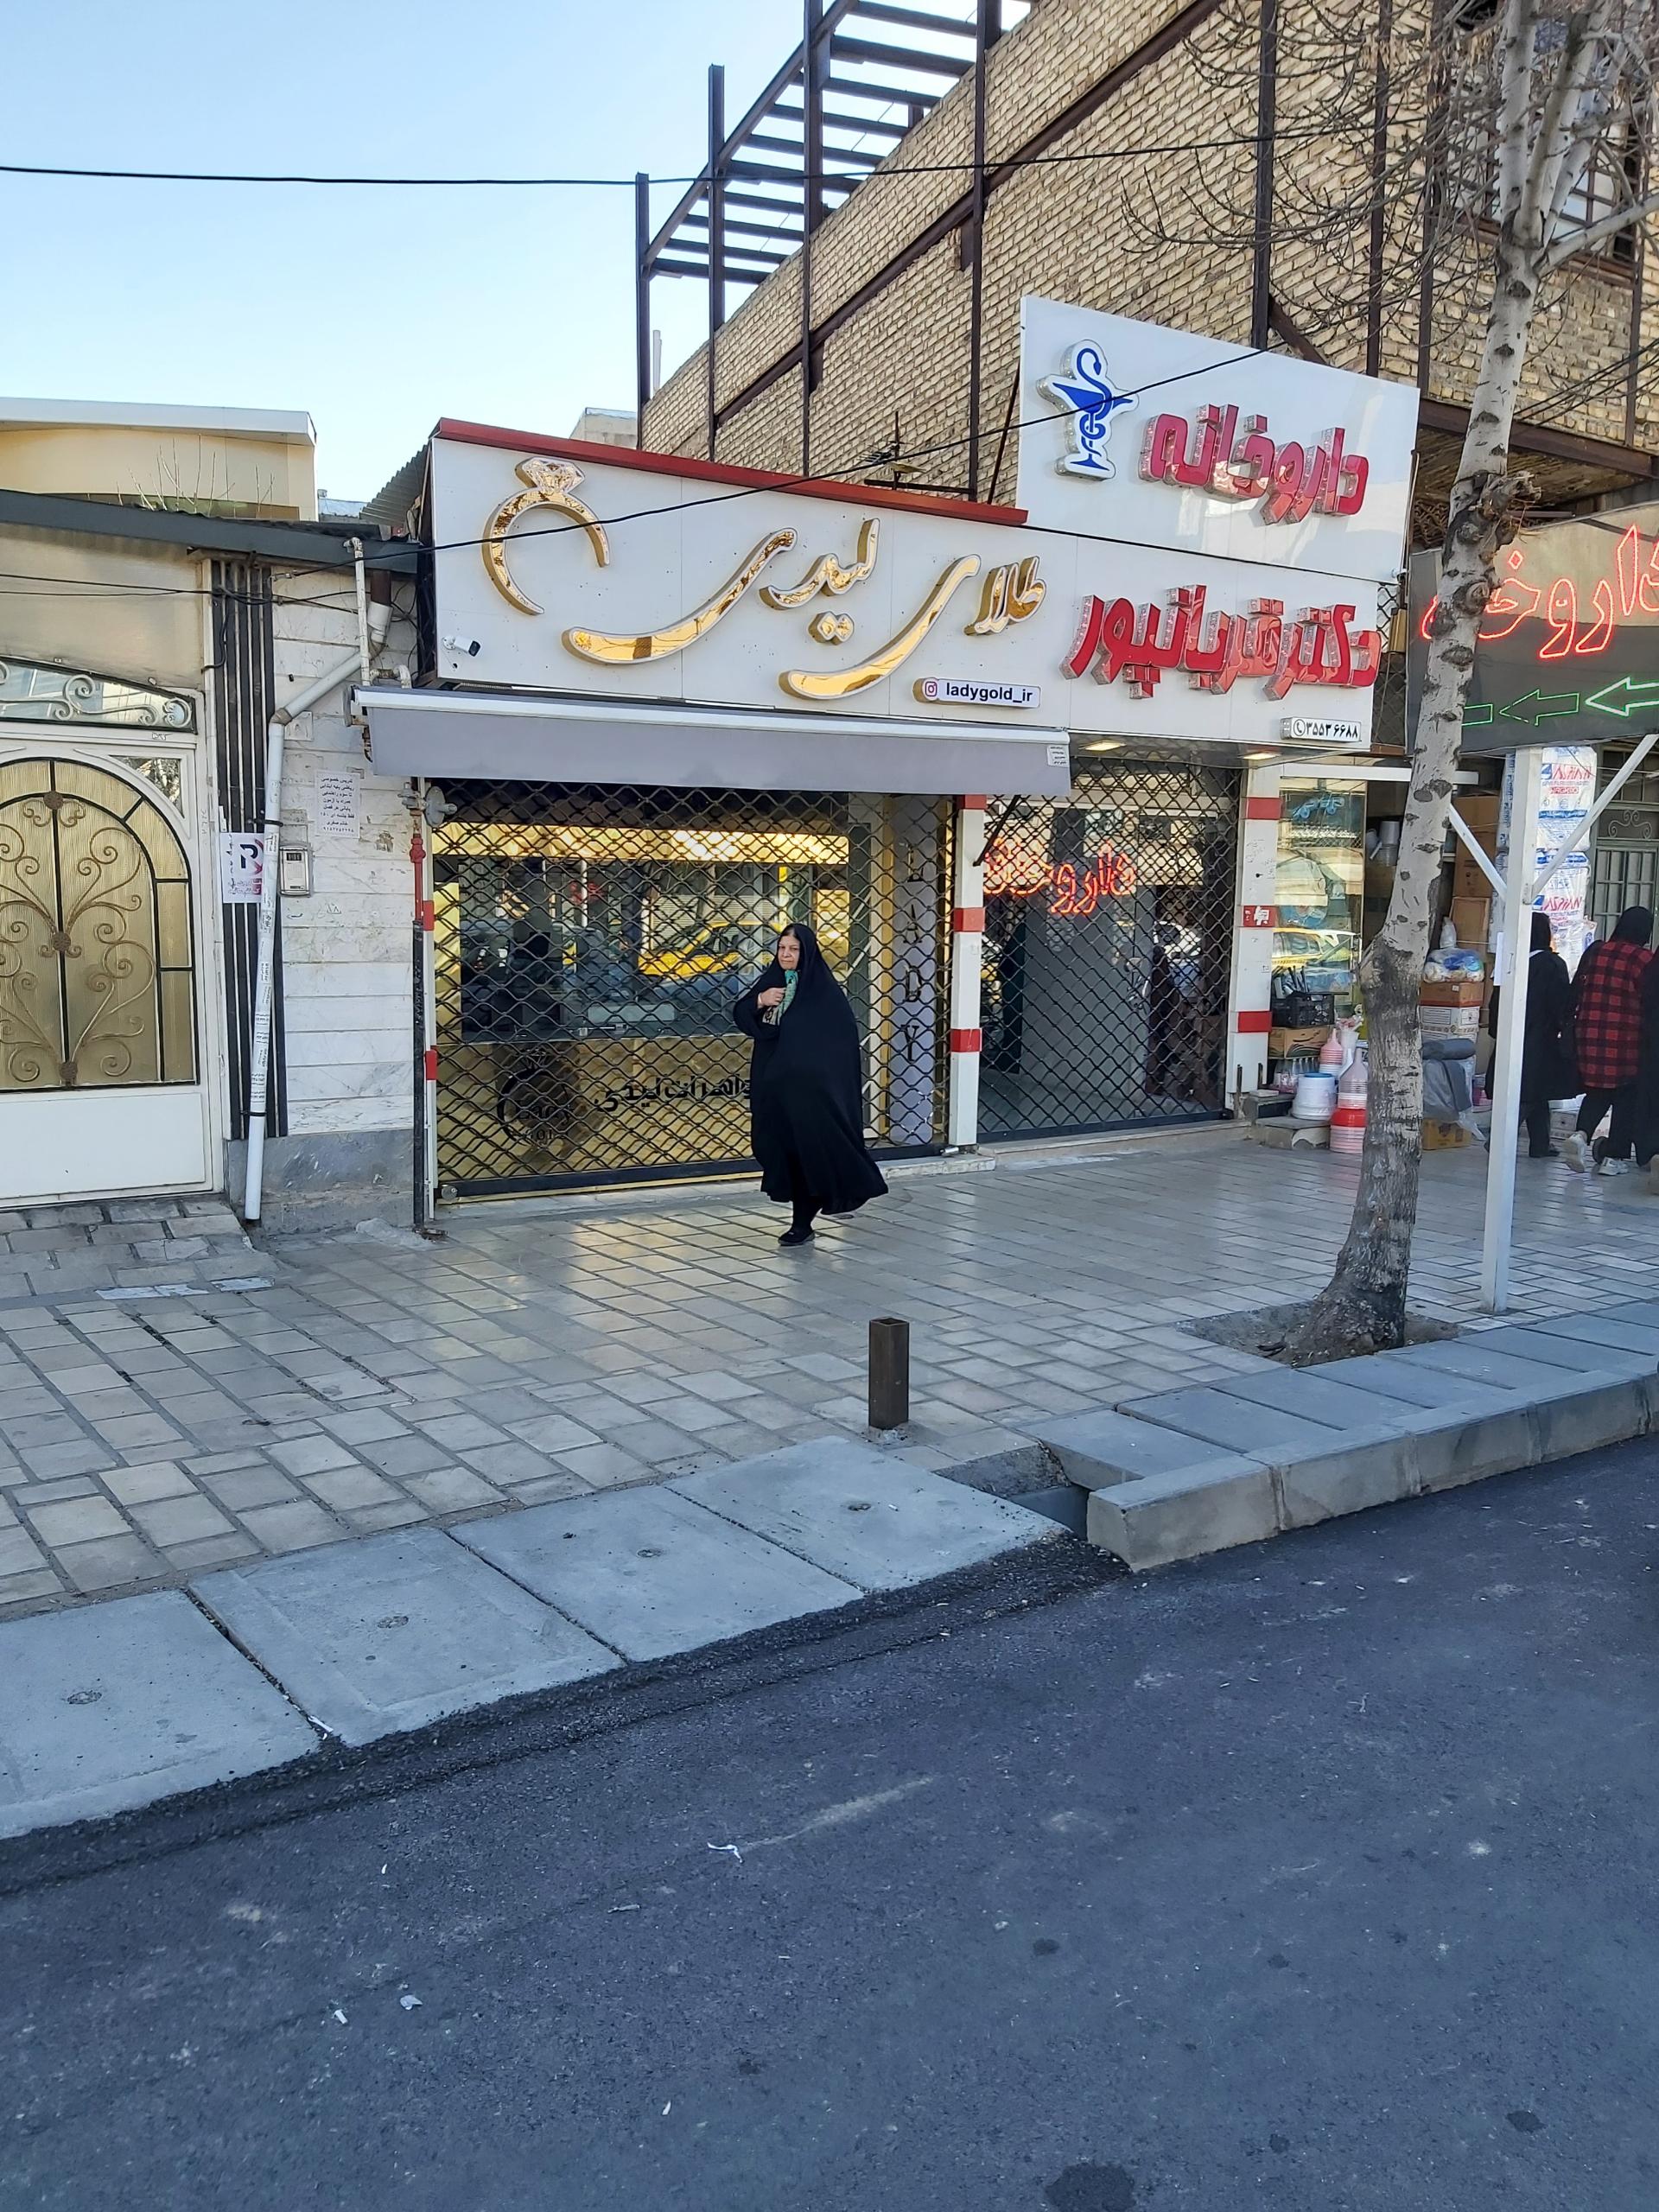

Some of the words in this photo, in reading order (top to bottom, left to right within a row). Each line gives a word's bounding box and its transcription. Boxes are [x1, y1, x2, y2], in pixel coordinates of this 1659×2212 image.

[1139, 403, 1370, 525] داروخانه
[946, 682, 1033, 703] ladygold_ir
[1059, 584, 1286, 700] قربانپور
[1263, 604, 1382, 700] دکتر
